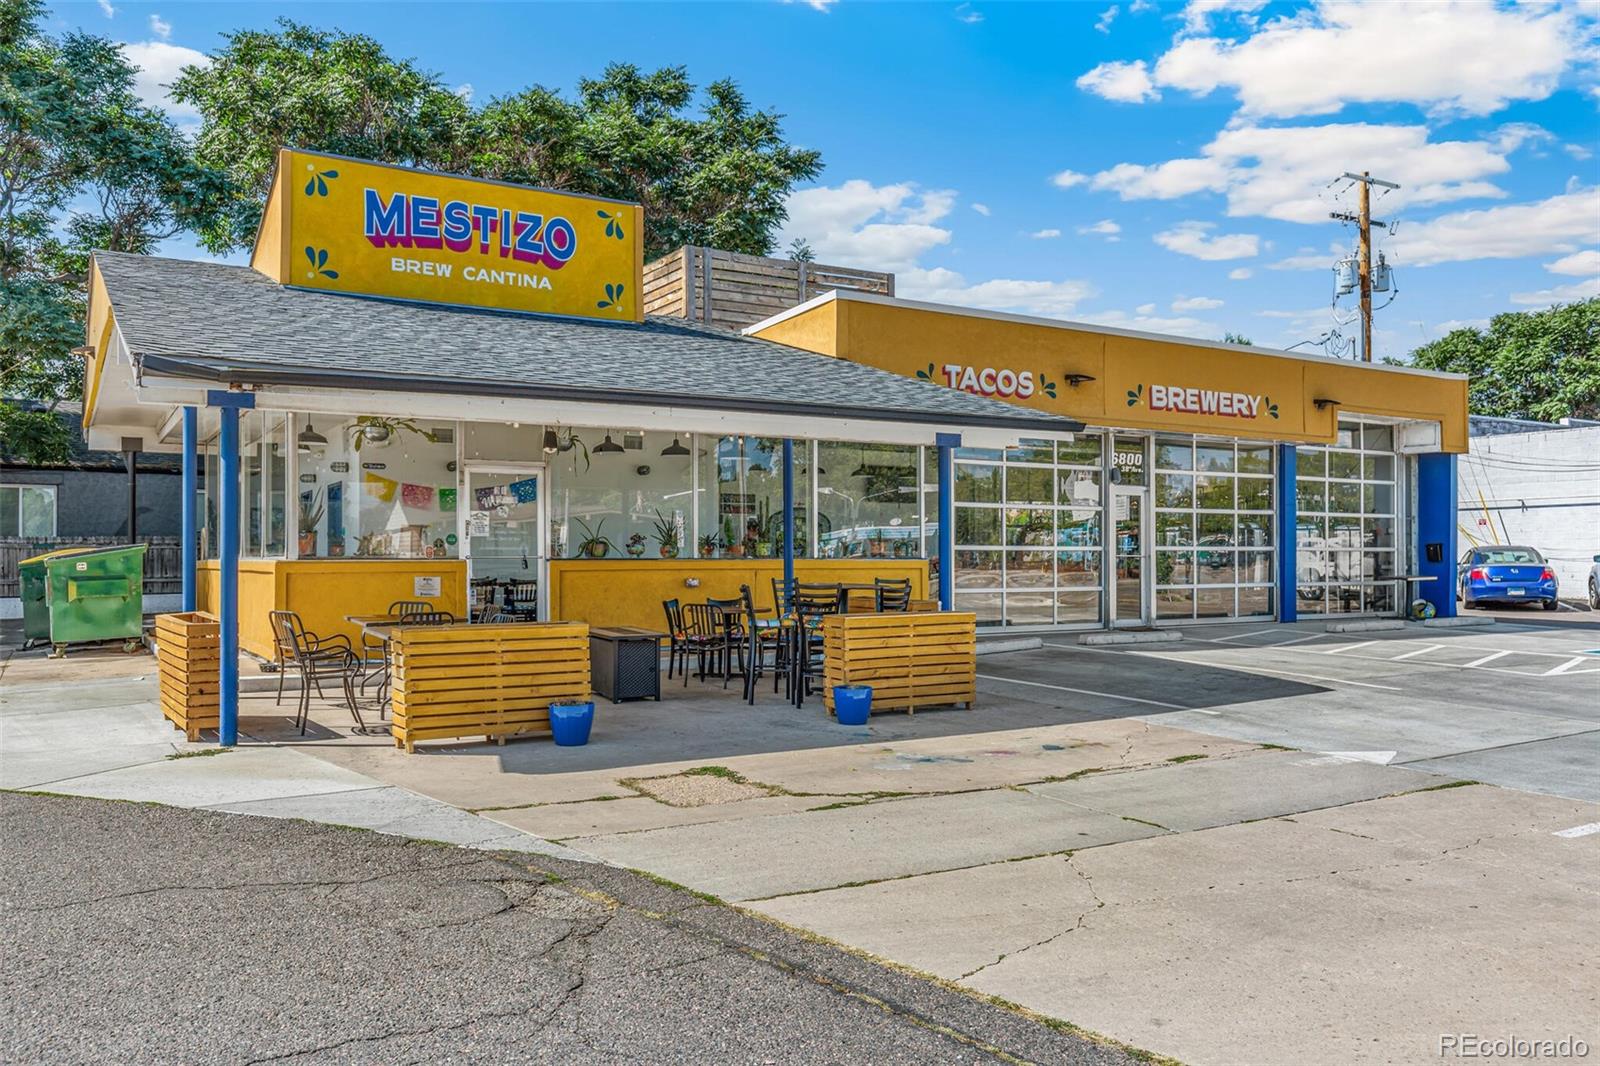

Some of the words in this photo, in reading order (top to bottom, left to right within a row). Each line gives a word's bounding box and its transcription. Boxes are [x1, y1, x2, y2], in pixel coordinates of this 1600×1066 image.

[364, 188, 577, 267] MESTIZO
[391, 258, 452, 278] BREW
[462, 266, 552, 290] CANTINA
[943, 364, 1034, 397] TACOS
[1149, 385, 1262, 417] BREWERY
[1112, 452, 1142, 465] 6800
